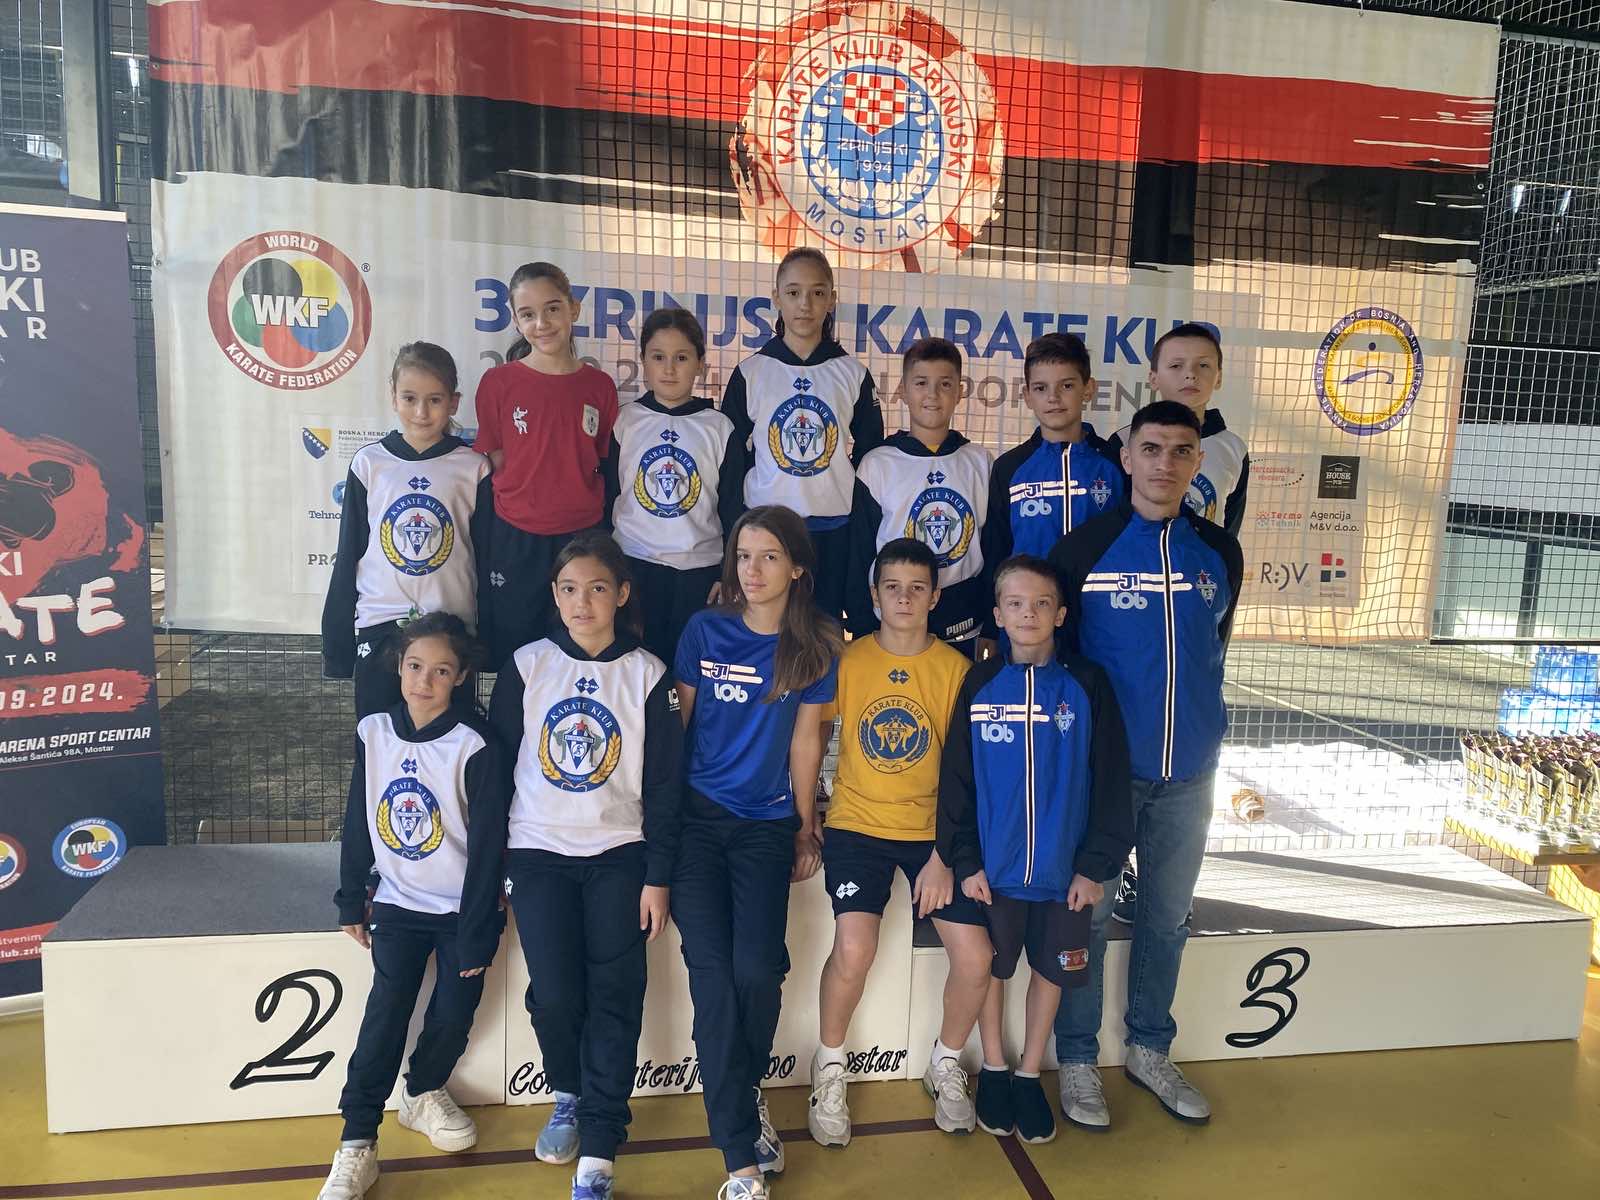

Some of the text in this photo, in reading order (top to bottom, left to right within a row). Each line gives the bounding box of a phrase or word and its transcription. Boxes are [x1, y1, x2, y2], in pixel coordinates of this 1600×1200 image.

[776, 39, 968, 180] KARATE KLUB ZRINJSKI
[855, 159, 893, 174] 1994
[805, 202, 929, 244] MOSTAR
[264, 234, 320, 253] WORLD
[251, 294, 329, 328] WKF
[1350, 311, 1363, 321] OF
[1370, 309, 1406, 330] BOSNIA
[1316, 320, 1347, 390] FEDERATION
[1408, 334, 1420, 356] AND
[225, 342, 358, 388] KARATE FEDERATION
[809, 401, 829, 419] KLUB
[1322, 397, 1348, 429] KARATE
[674, 452, 693, 469] KLUB
[1325, 472, 1351, 481] HOUSE
[391, 498, 422, 517] KARATE
[944, 492, 965, 511] KLUB
[1310, 511, 1351, 522] Agencija
[1309, 523, 1360, 532] M&V d.o.o.
[551, 702, 614, 729] KARATE KLUB
[867, 699, 924, 721] KARATE KLUB
[49, 731, 97, 749] SPORT
[98, 726, 151, 743] CENTAR
[30, 750, 62, 761] Šantića
[63, 748, 84, 757] 98A,
[85, 744, 114, 753] Mostar
[72, 840, 107, 857] WKF
[1225, 946, 1311, 1049] 3
[229, 968, 343, 1090] 2
